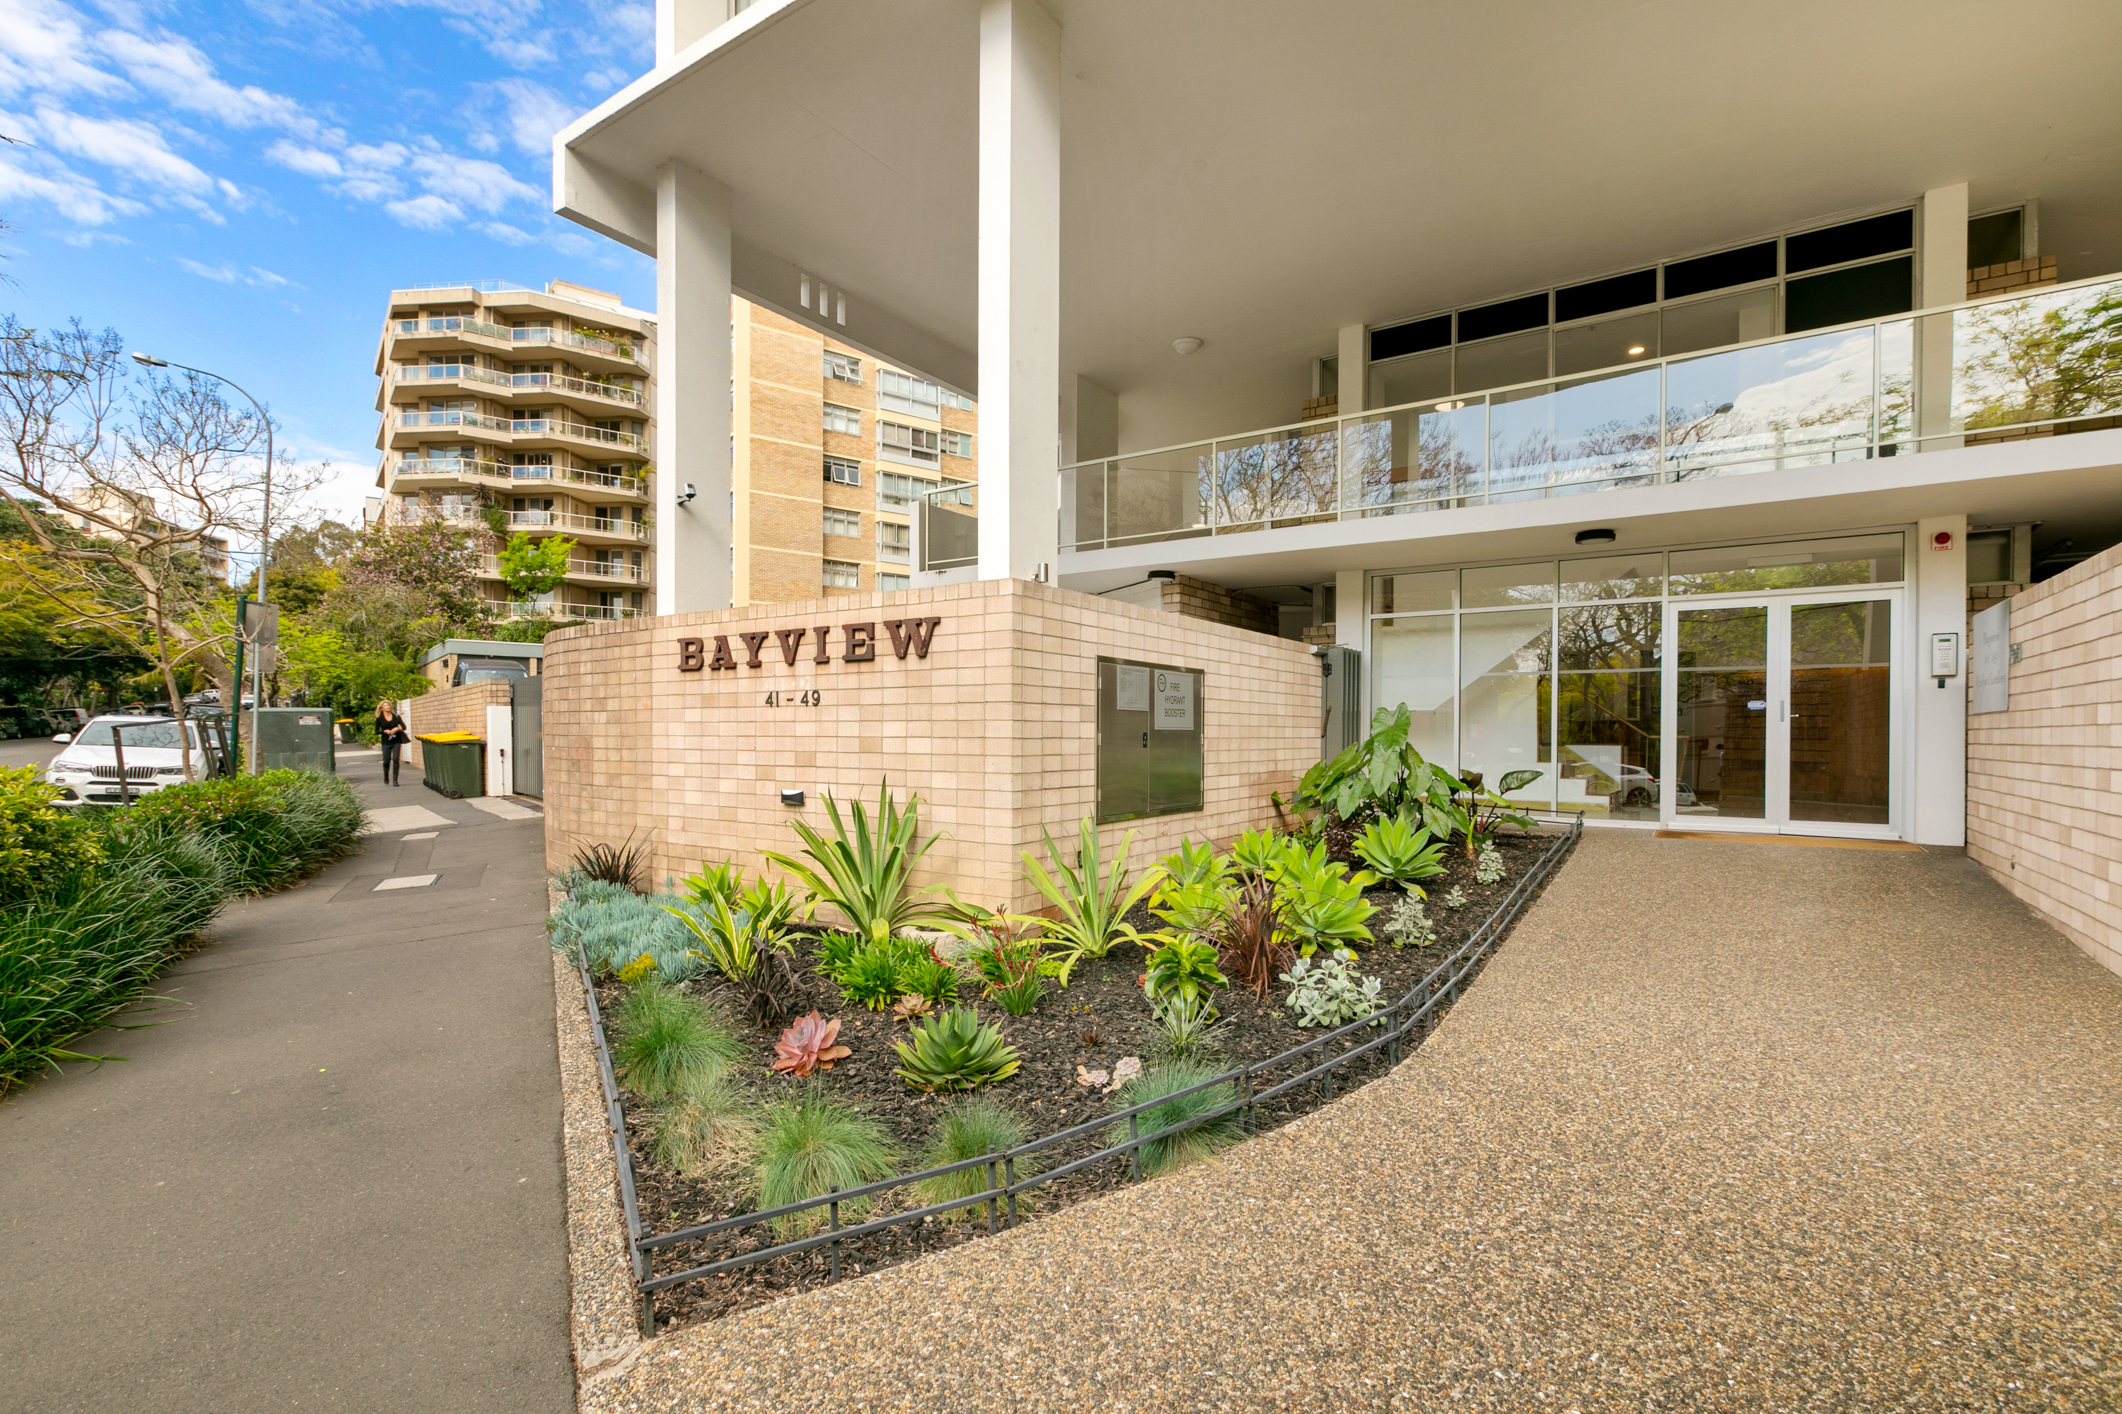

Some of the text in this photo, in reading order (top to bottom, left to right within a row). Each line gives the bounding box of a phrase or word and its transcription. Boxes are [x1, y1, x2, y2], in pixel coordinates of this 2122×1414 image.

[677, 616, 941, 672] BAYVIEW
[1170, 682, 1180, 692] FIRE
[1164, 695, 1186, 705] HYDRANT
[1164, 707, 1186, 718] BOOSTER
